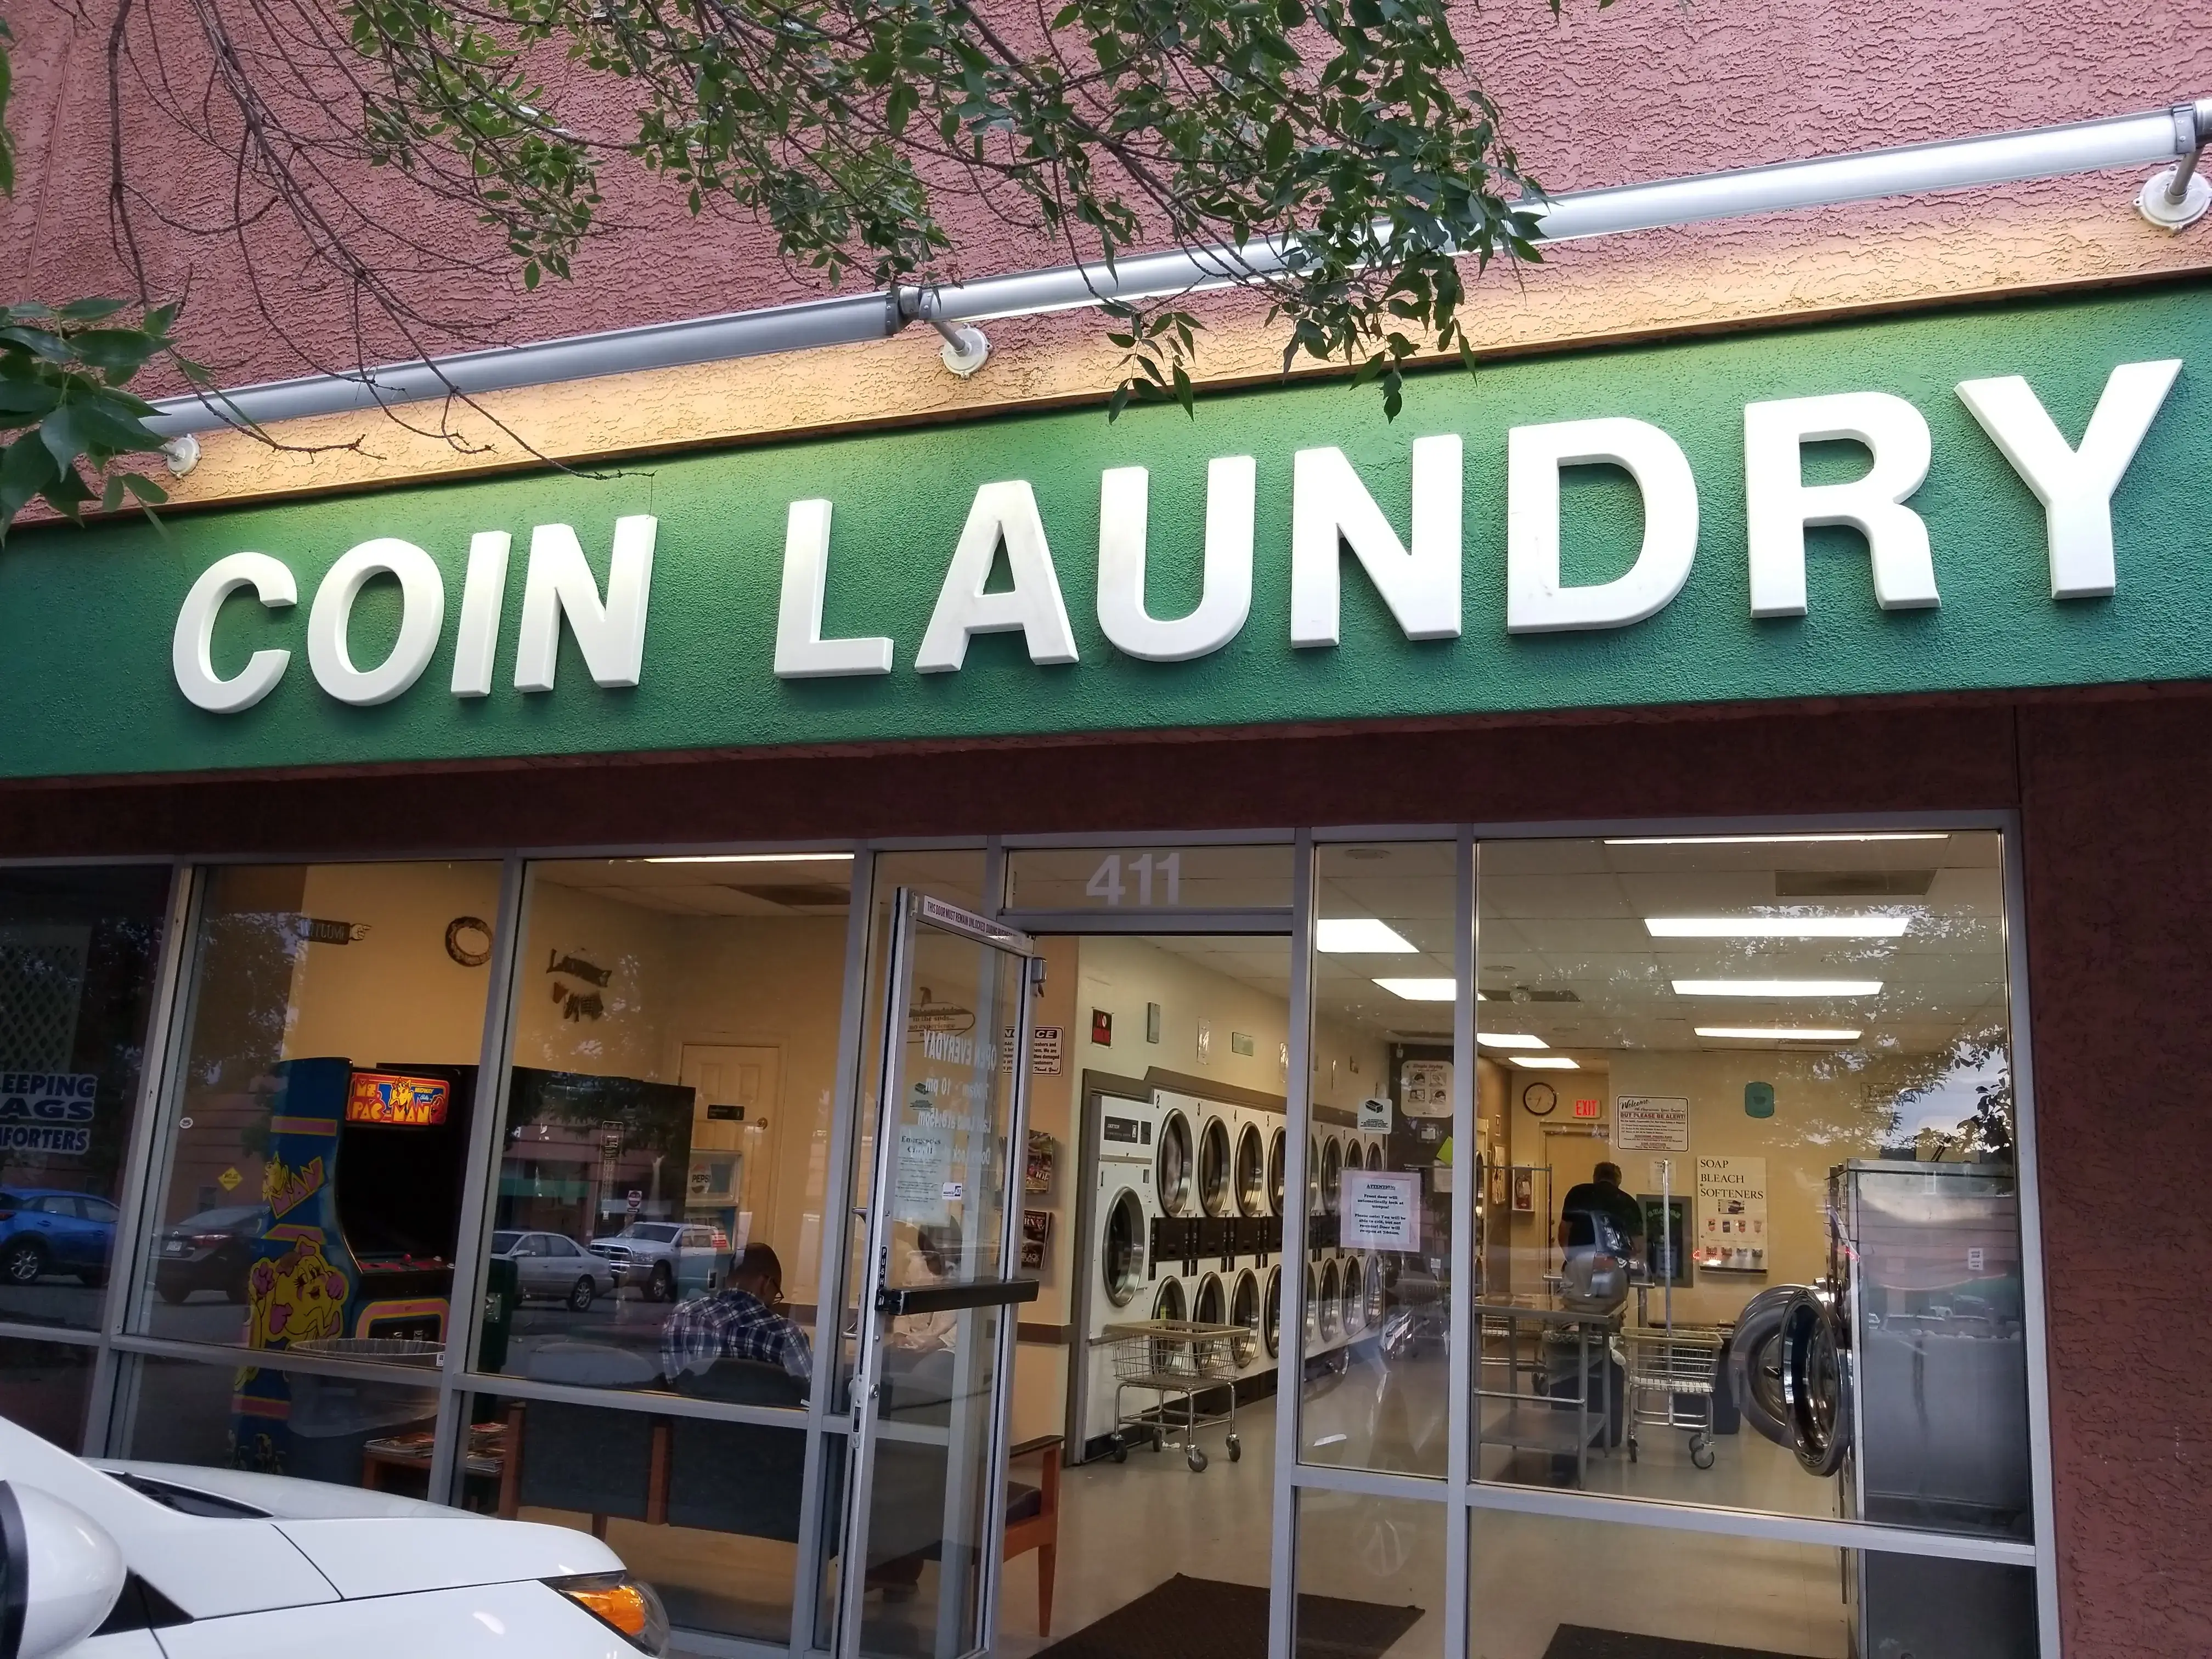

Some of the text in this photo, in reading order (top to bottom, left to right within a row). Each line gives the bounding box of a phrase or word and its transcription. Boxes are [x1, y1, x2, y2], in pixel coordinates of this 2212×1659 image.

[172, 359, 2183, 713] COIN LAUNDRY
[1086, 853, 1180, 906] 411
[928, 901, 936, 914] THIS
[936, 904, 946, 918] DOOR
[946, 908, 955, 922] MUST
[956, 912, 968, 926] REMAIN
[969, 917, 986, 933] UNLOCKED
[1156, 1094, 1160, 1109] 2
[1576, 1100, 1597, 1116] EXIT
[1197, 1103, 1201, 1116] 3
[1234, 1109, 1237, 1122] 4
[1700, 1159, 1729, 1169] SOAP
[1701, 1173, 1745, 1183] BLEACH
[1700, 1188, 1764, 1200] SOFTENERS
